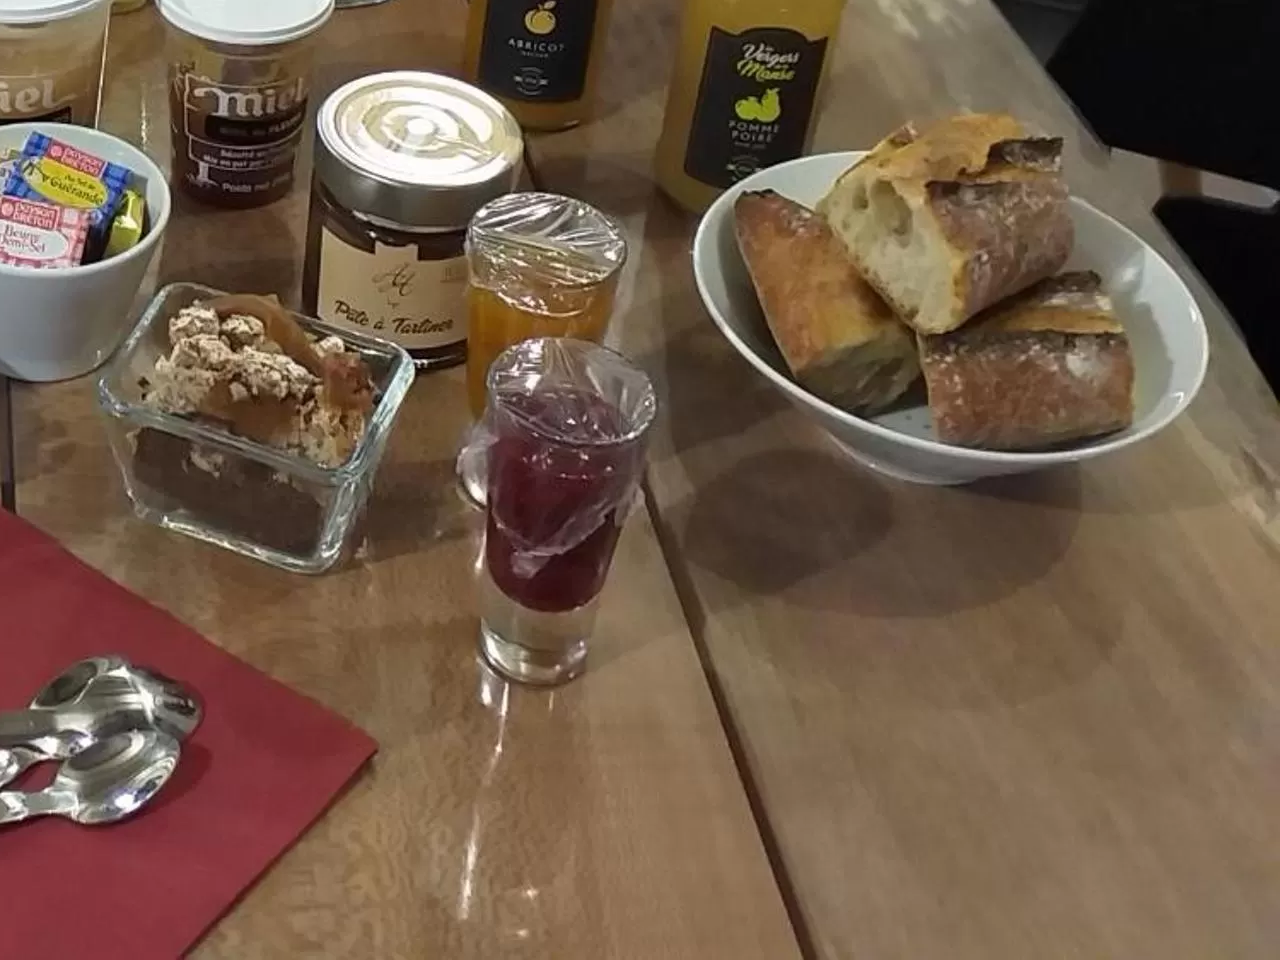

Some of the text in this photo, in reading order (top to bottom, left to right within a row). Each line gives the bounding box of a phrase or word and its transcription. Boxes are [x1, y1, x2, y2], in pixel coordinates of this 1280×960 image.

[508, 38, 565, 53] ABRICOT
[742, 43, 800, 68] Vergers
[194, 77, 304, 117] miel
[728, 120, 780, 133] POMME
[731, 132, 773, 143] POIRE
[373, 316, 385, 330] à
[391, 317, 454, 335] Tartiner
